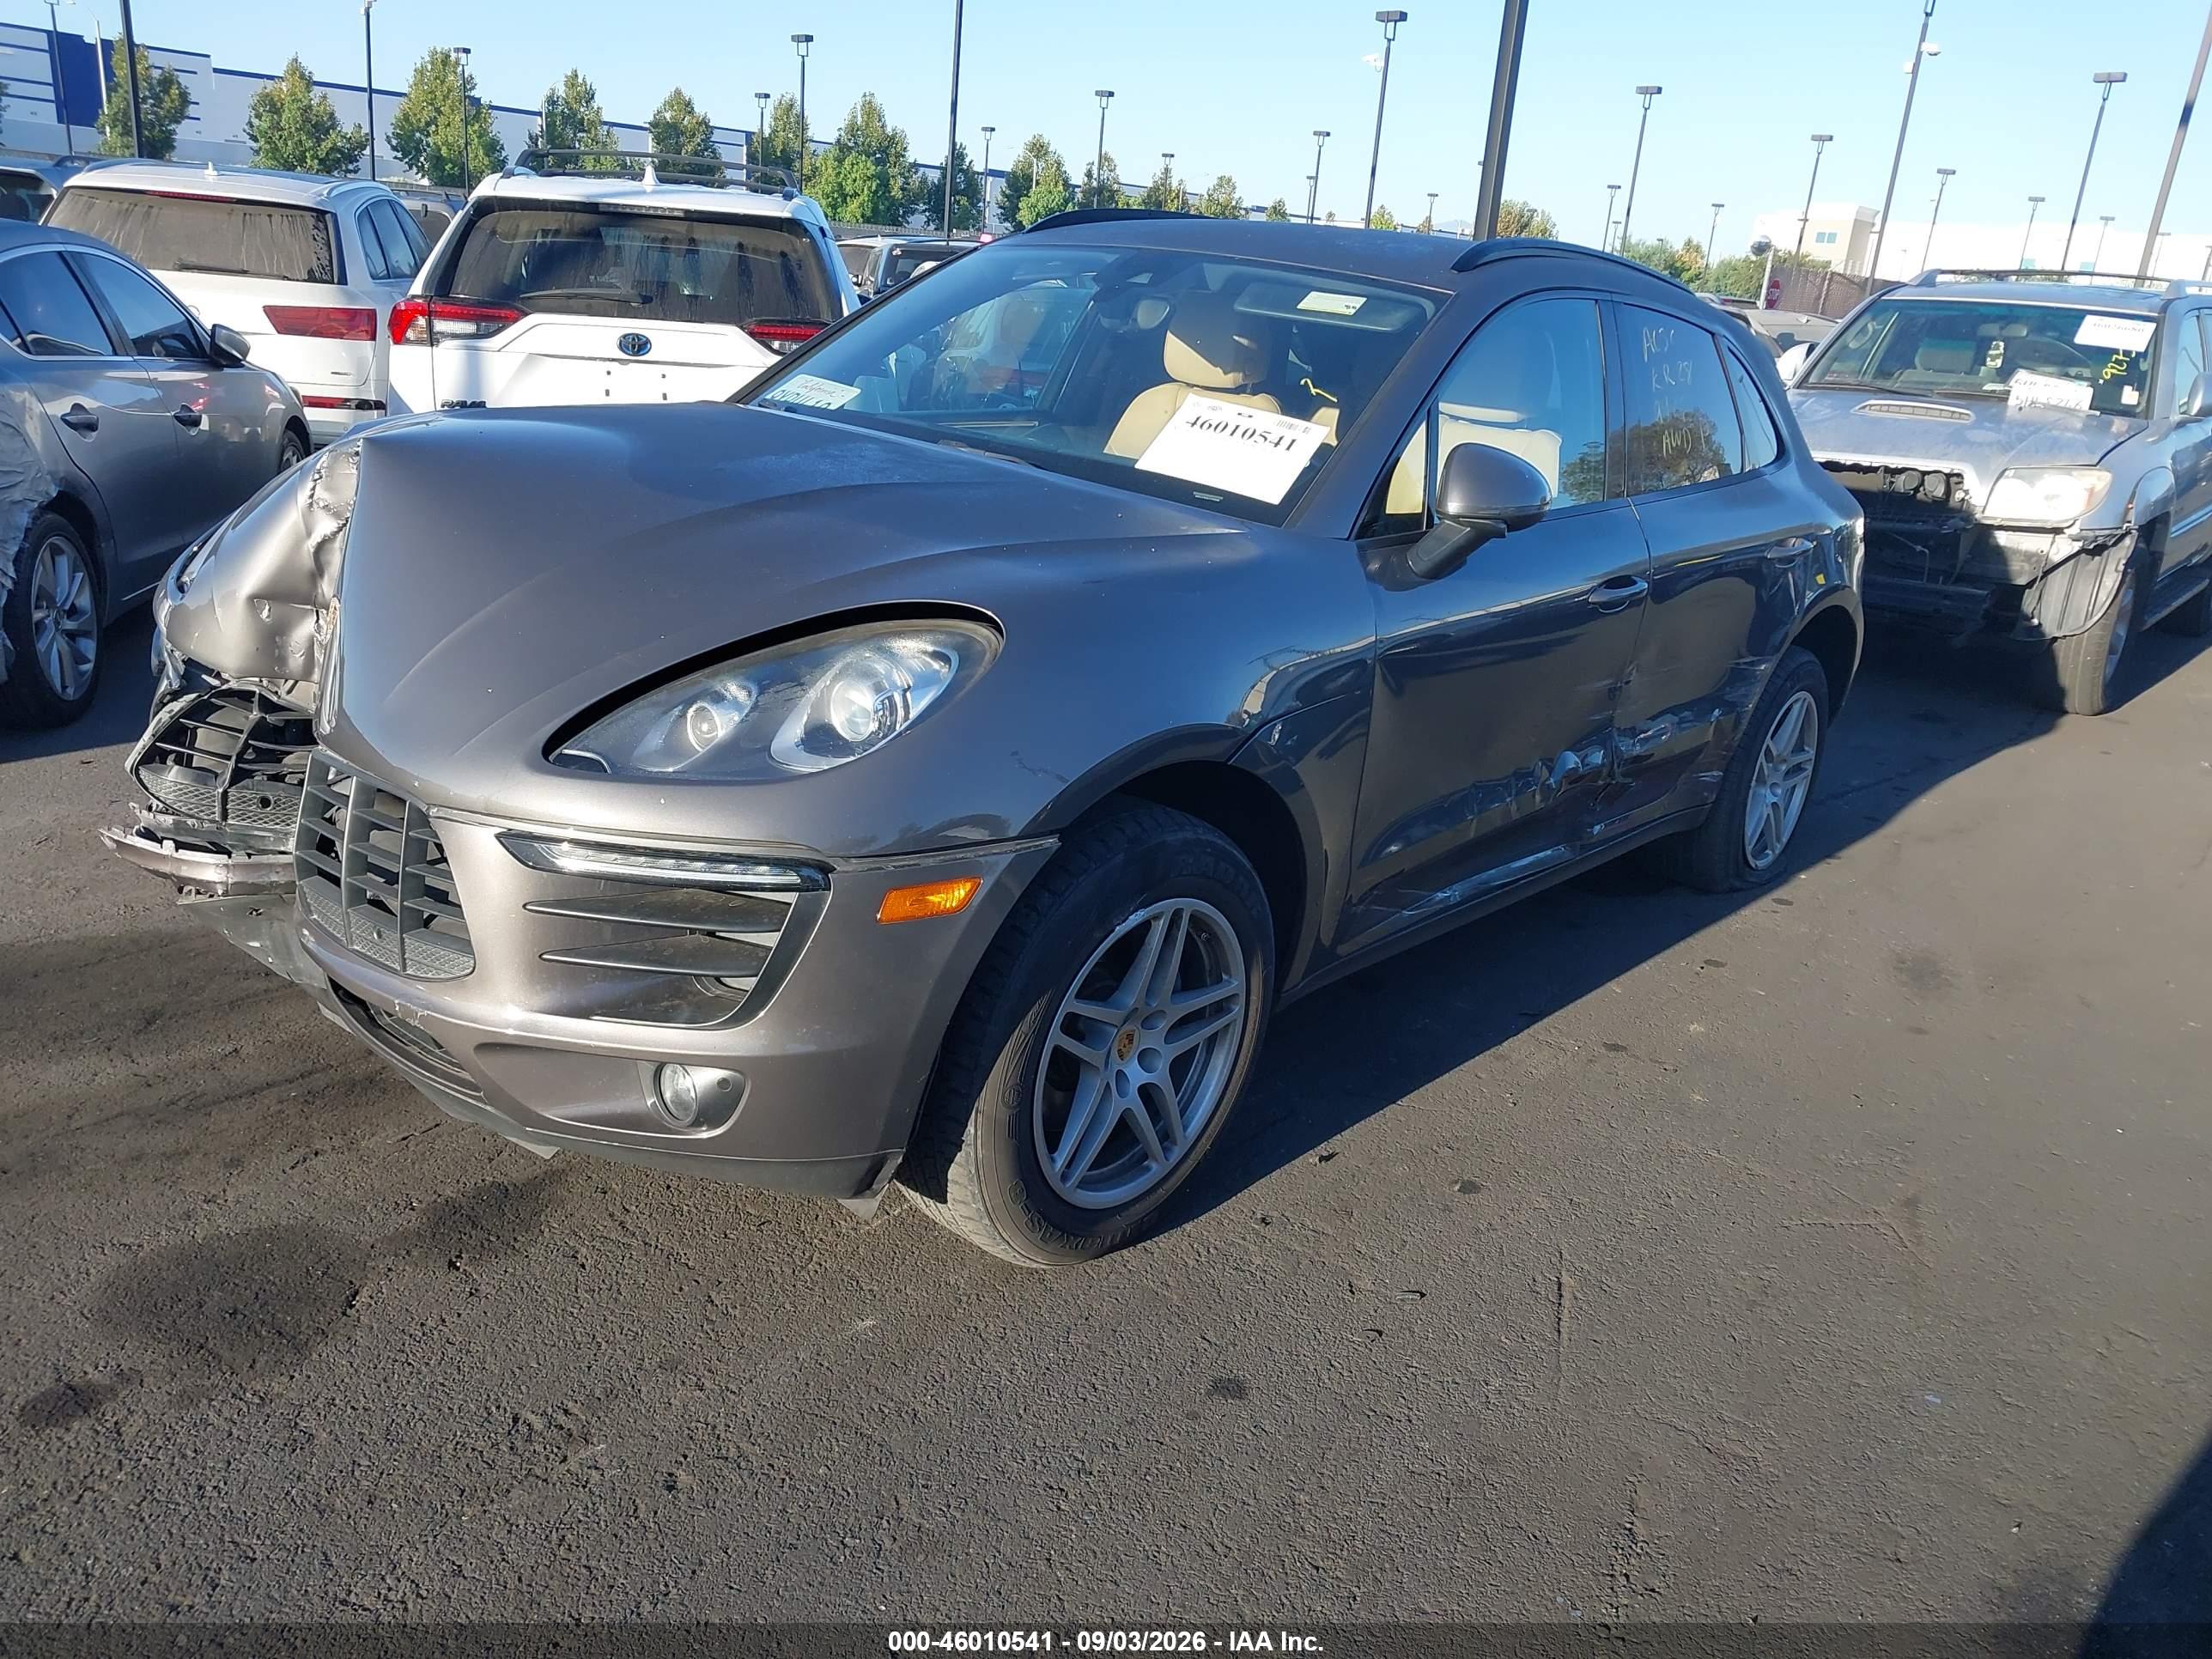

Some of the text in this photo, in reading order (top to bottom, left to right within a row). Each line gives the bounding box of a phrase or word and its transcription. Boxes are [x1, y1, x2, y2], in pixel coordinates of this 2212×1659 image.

[441, 399, 487, 408] RAV4
[1185, 415, 1297, 452] 46010541
[1662, 427, 1692, 459] AWD
